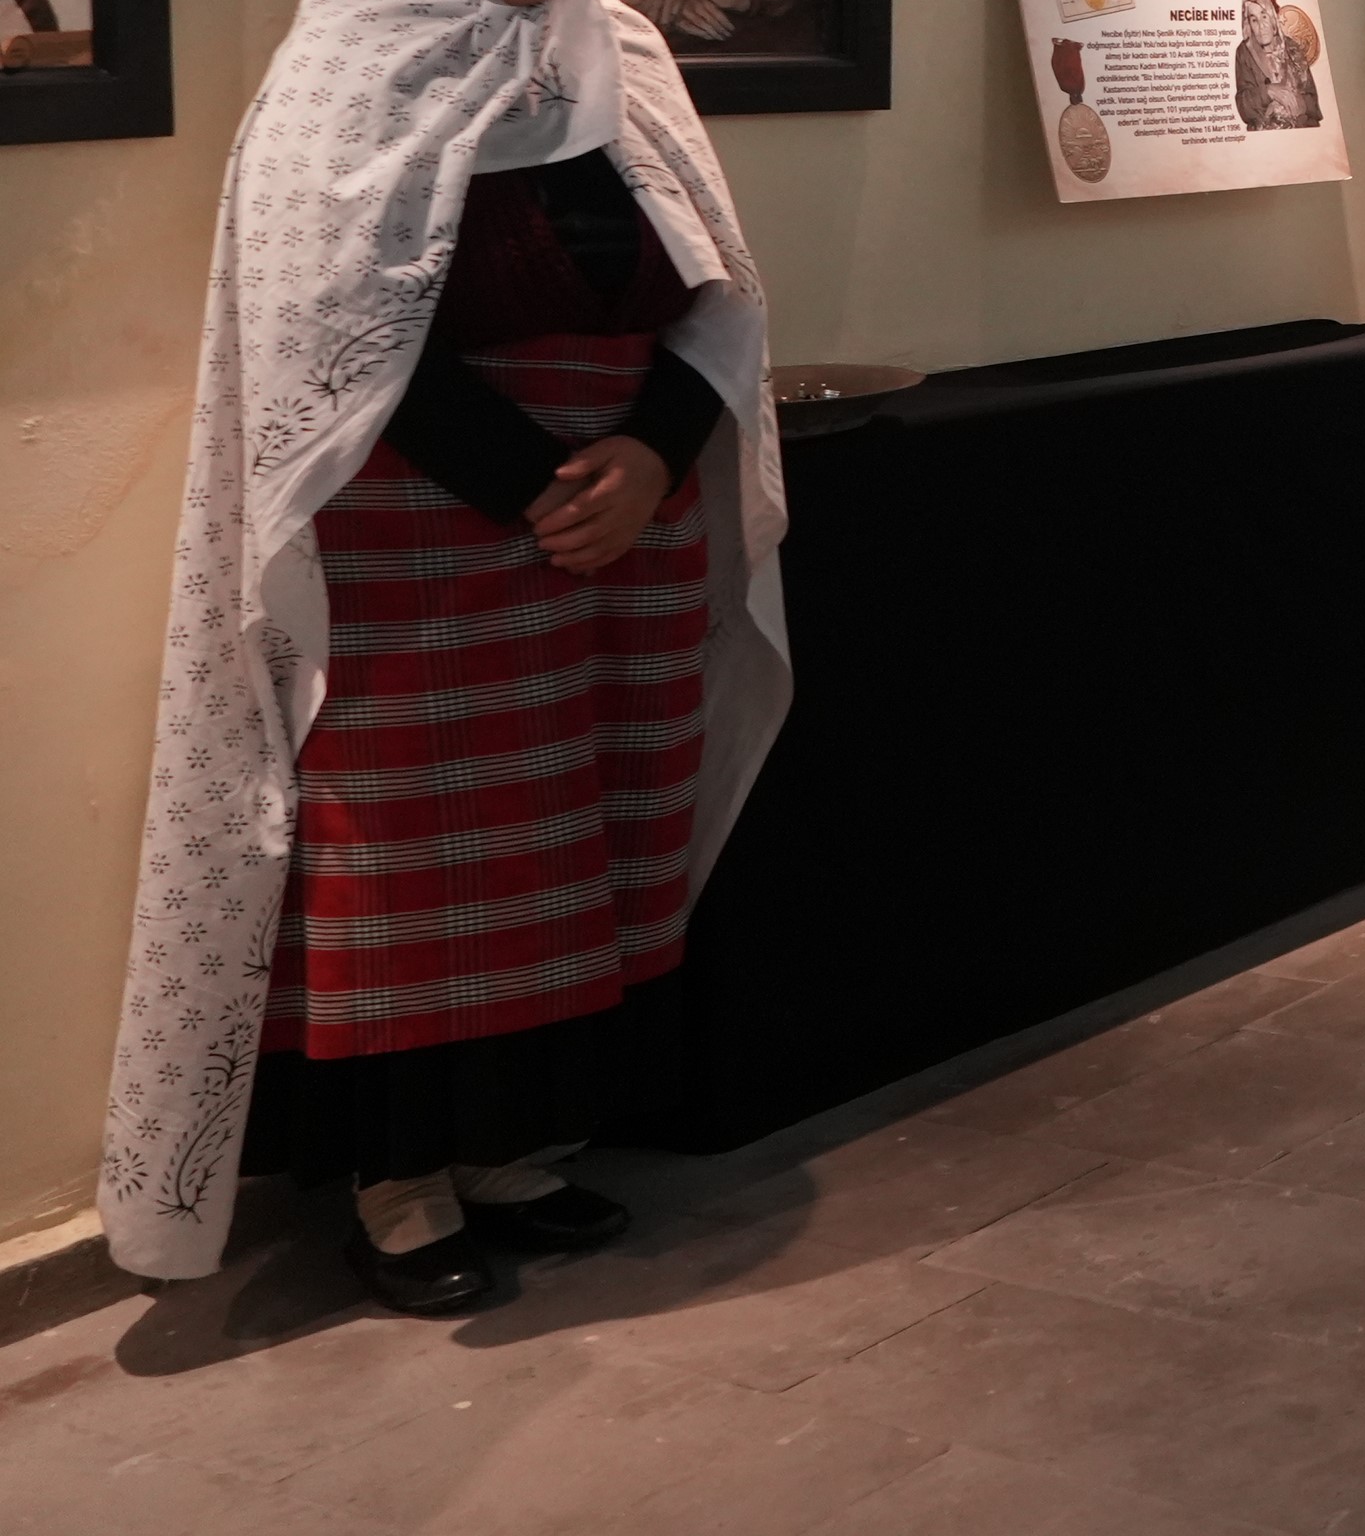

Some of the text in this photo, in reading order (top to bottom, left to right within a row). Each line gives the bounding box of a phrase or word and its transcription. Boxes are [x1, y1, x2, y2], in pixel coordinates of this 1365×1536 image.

[1169, 9, 1236, 22] NECİBE NİNE
[1211, 124, 1226, 133] Mart
